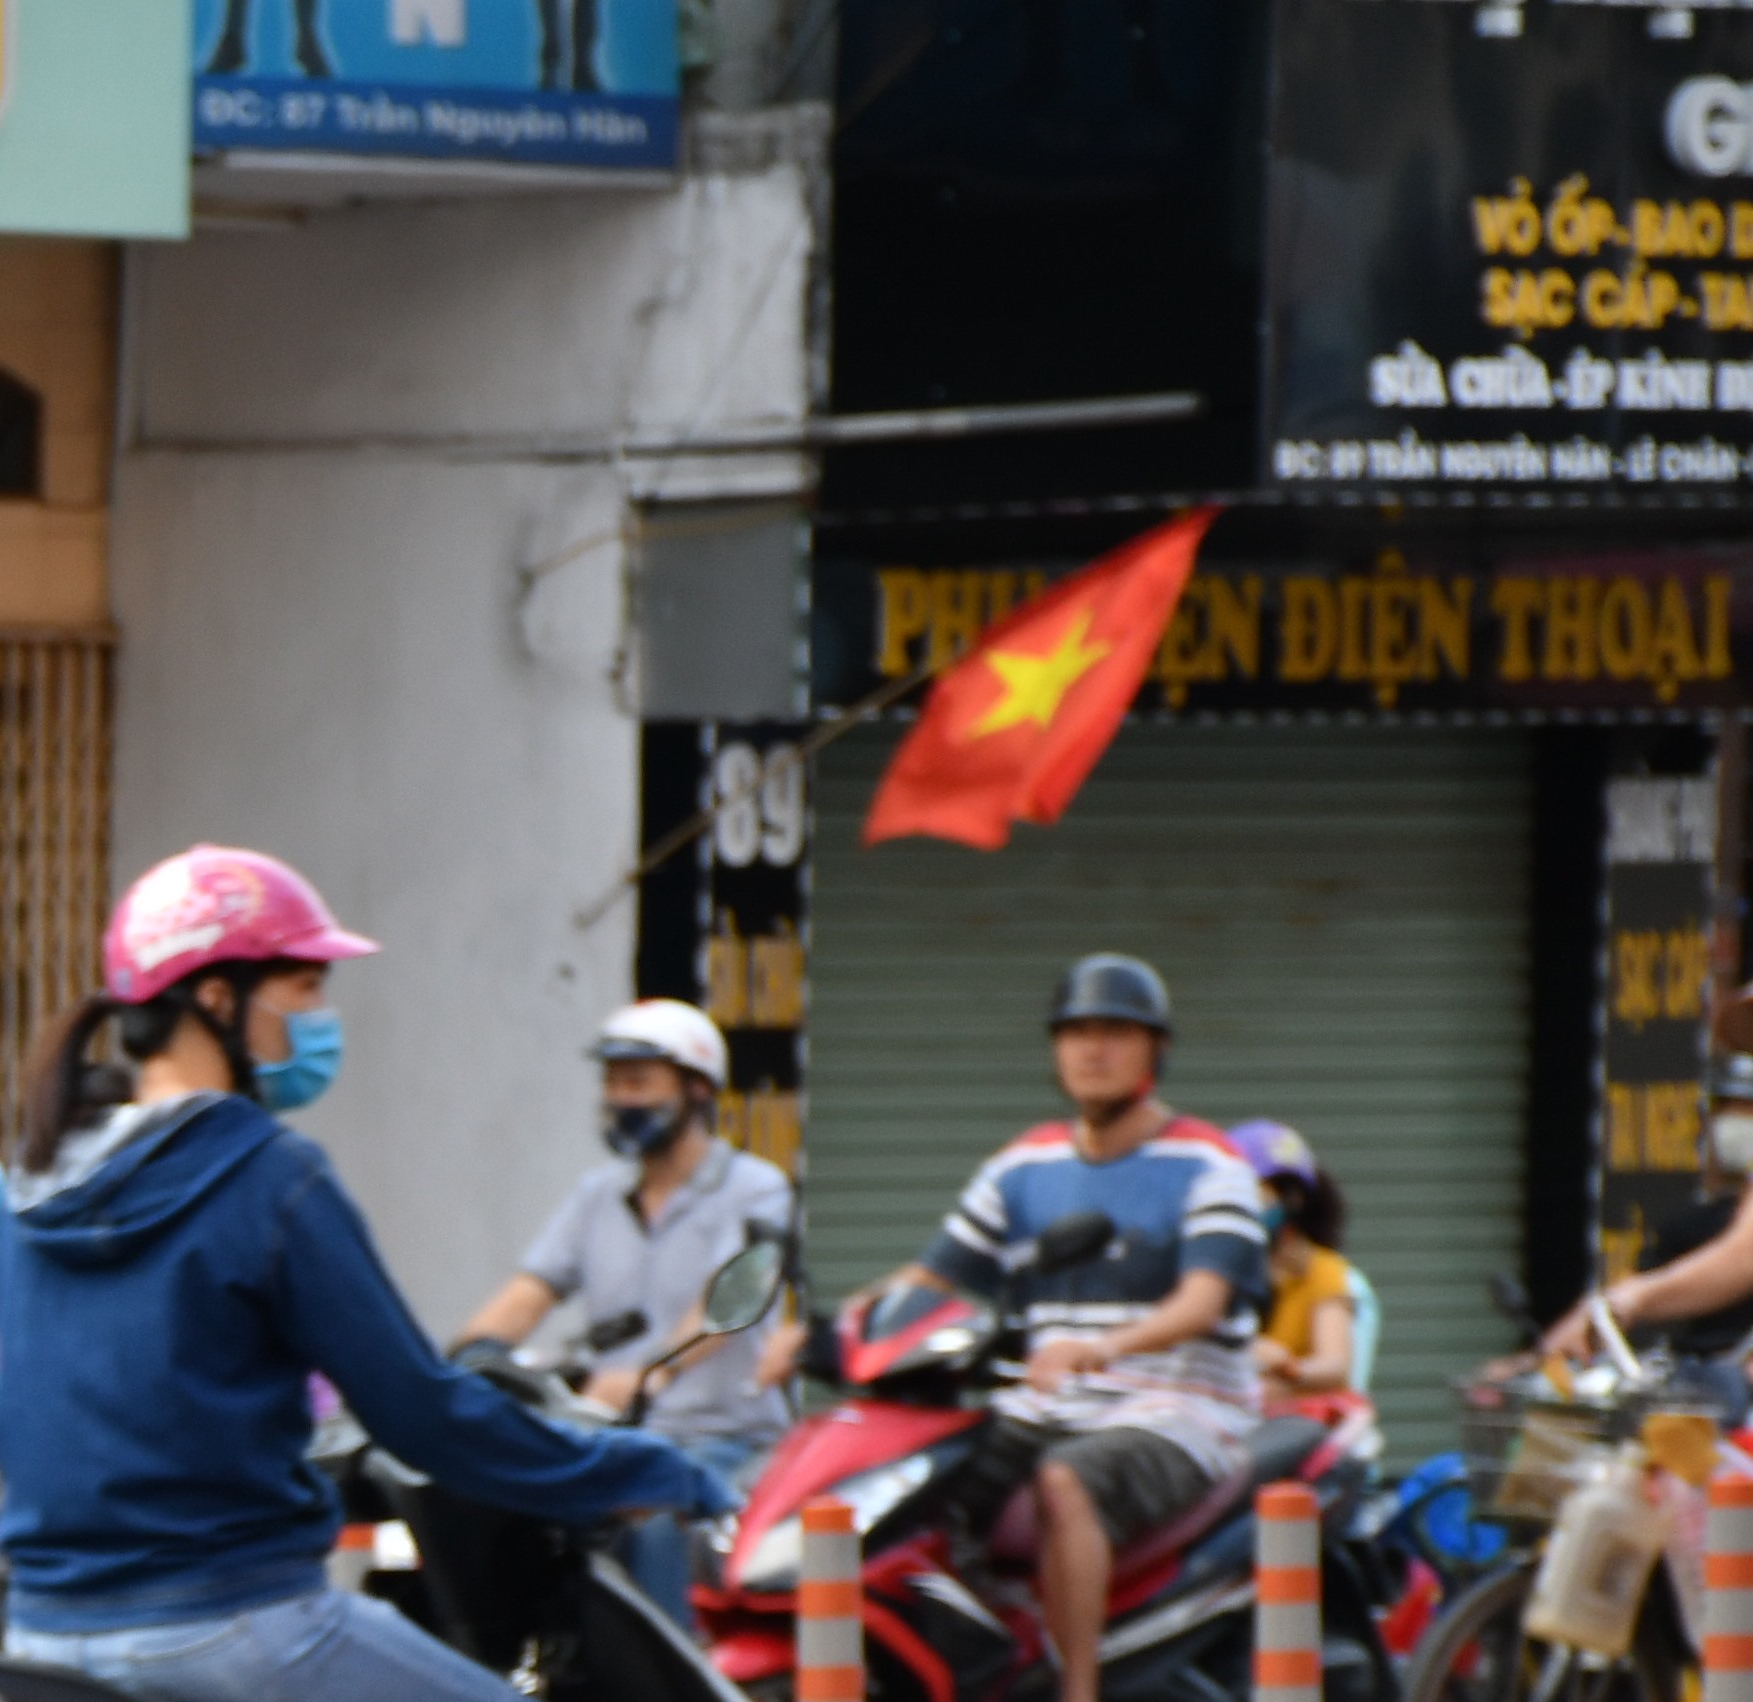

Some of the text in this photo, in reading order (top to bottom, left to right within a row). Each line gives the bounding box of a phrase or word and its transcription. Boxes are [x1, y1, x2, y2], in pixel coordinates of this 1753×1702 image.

[1278, 548, 1474, 706] ĐIỆN
[1494, 574, 1735, 704] THOẠI
[713, 741, 806, 867] 89
